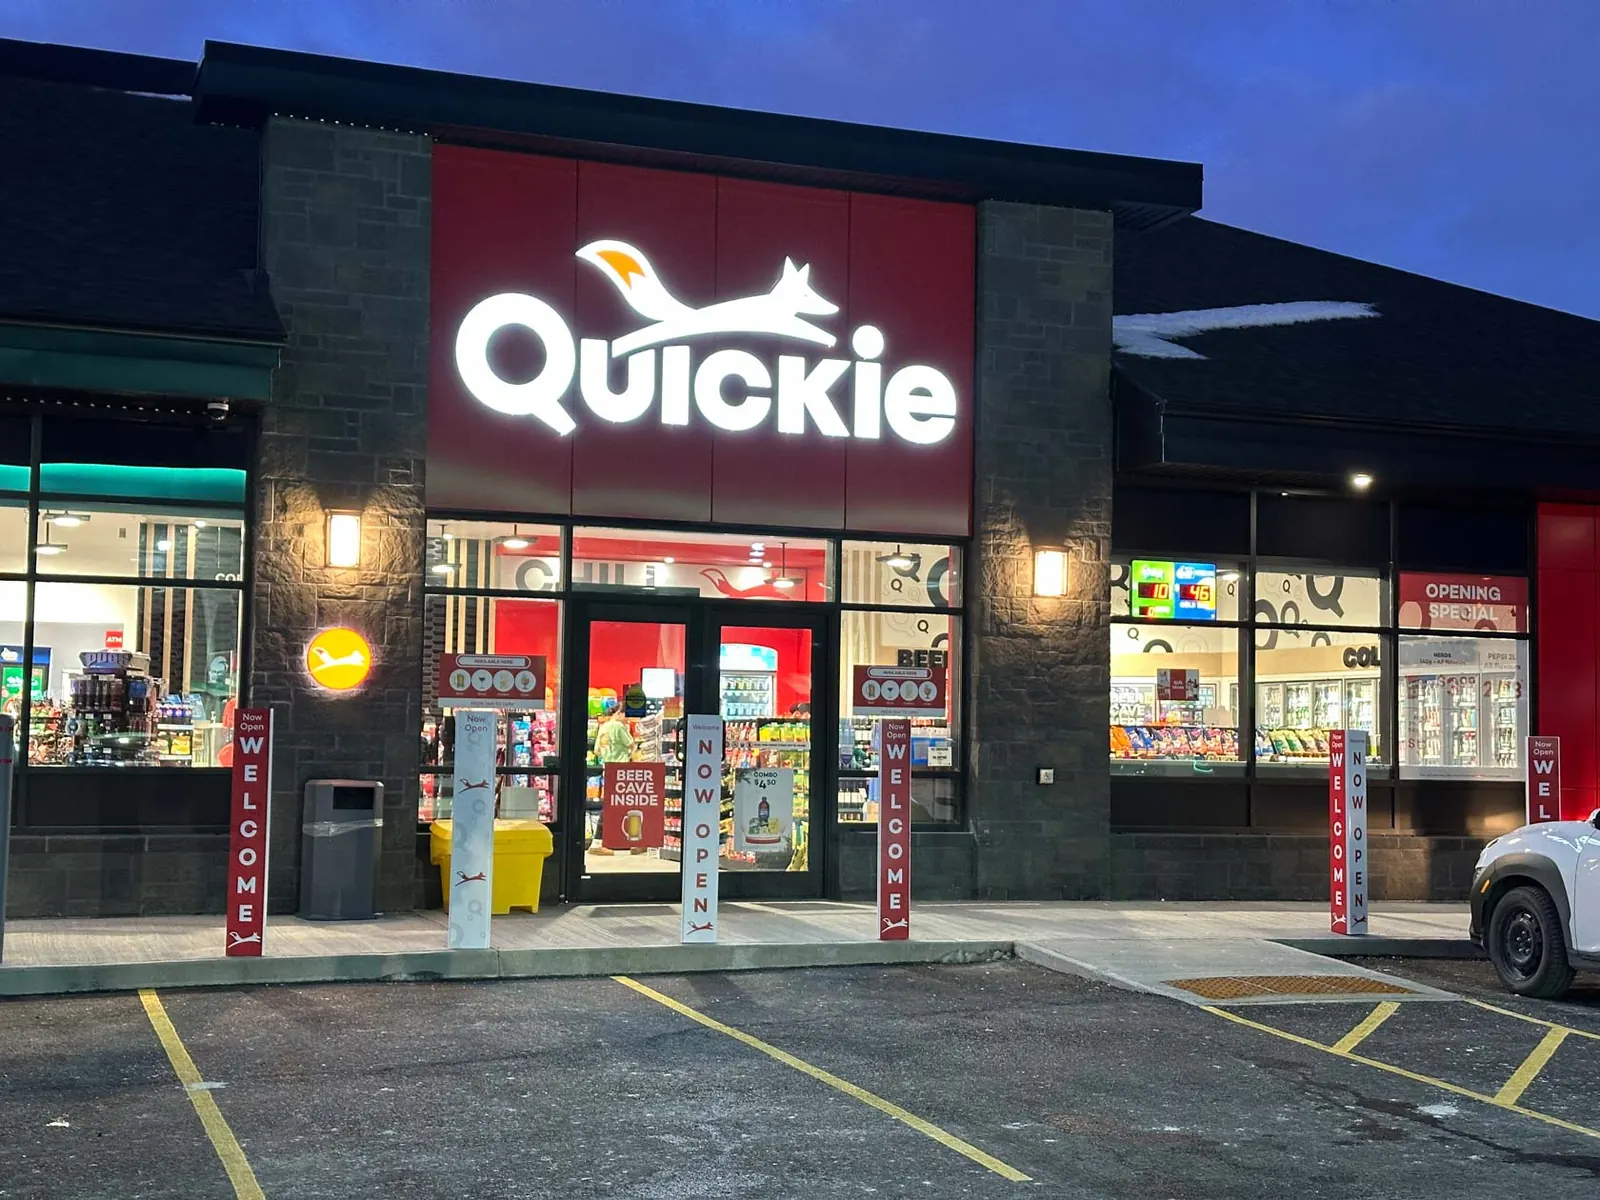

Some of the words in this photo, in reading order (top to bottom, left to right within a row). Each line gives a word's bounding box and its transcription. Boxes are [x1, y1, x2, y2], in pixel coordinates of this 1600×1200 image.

[1425, 583, 1501, 601] OPENING
[1428, 604, 1499, 621] SPECIAL
[242, 713, 262, 721] Now
[467, 715, 486, 723] Now
[240, 723, 264, 732] Open
[464, 724, 488, 733] Open
[888, 723, 904, 731] Now
[886, 732, 906, 740] Open
[1331, 741, 1343, 749] Open
[1533, 748, 1554, 756] Open
[616, 769, 653, 781] BEER
[694, 739, 714, 803] NOW
[1352, 751, 1364, 809] NOW
[615, 782, 655, 794] CAVE
[610, 794, 659, 806] INSIDE
[236, 736, 265, 922] WELCOME
[886, 744, 907, 910] WELCOME
[1331, 752, 1344, 906] WELCOME
[694, 824, 711, 913] OPEN
[1353, 827, 1363, 907] OPEN
